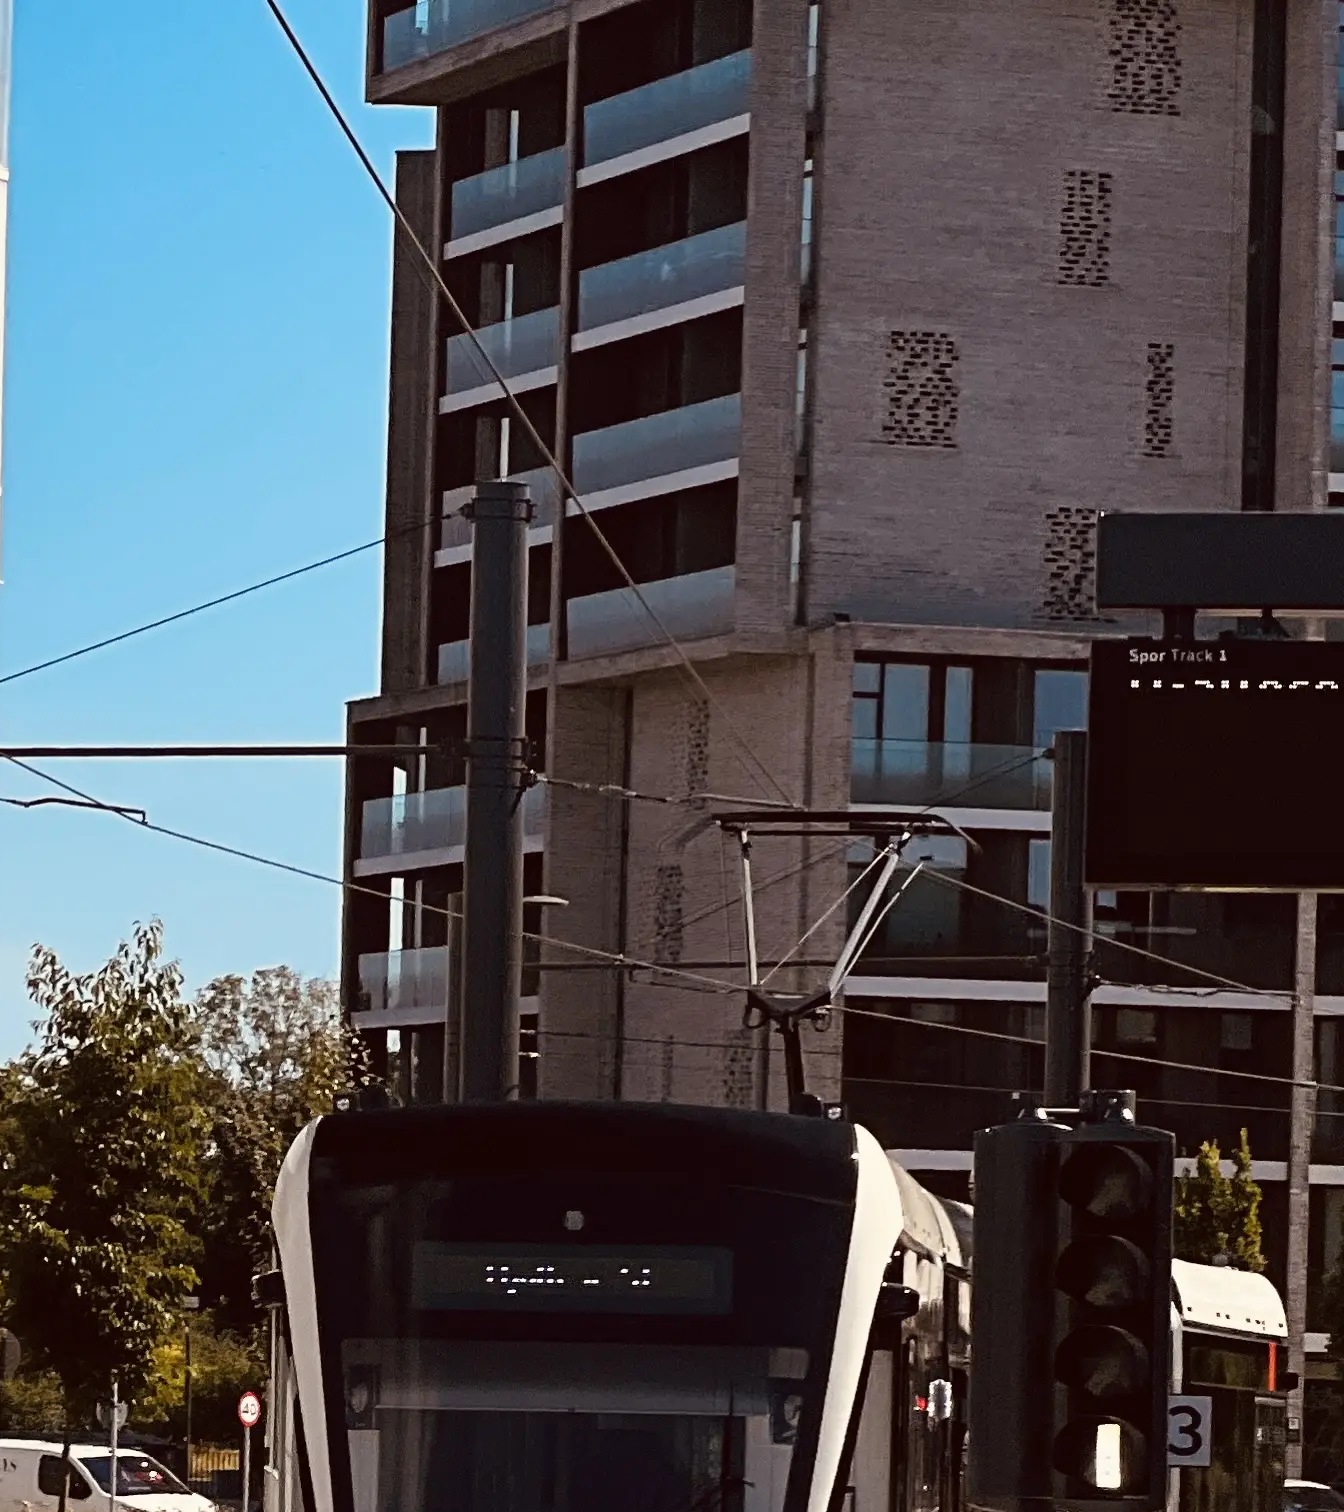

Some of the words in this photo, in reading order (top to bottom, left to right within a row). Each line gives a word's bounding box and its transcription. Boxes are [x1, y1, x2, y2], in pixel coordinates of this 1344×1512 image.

[1129, 648, 1166, 665] Spor
[1171, 648, 1213, 662] Track
[1219, 649, 1228, 662] 1
[242, 1402, 257, 1416] 40
[1168, 1405, 1203, 1456] 3
